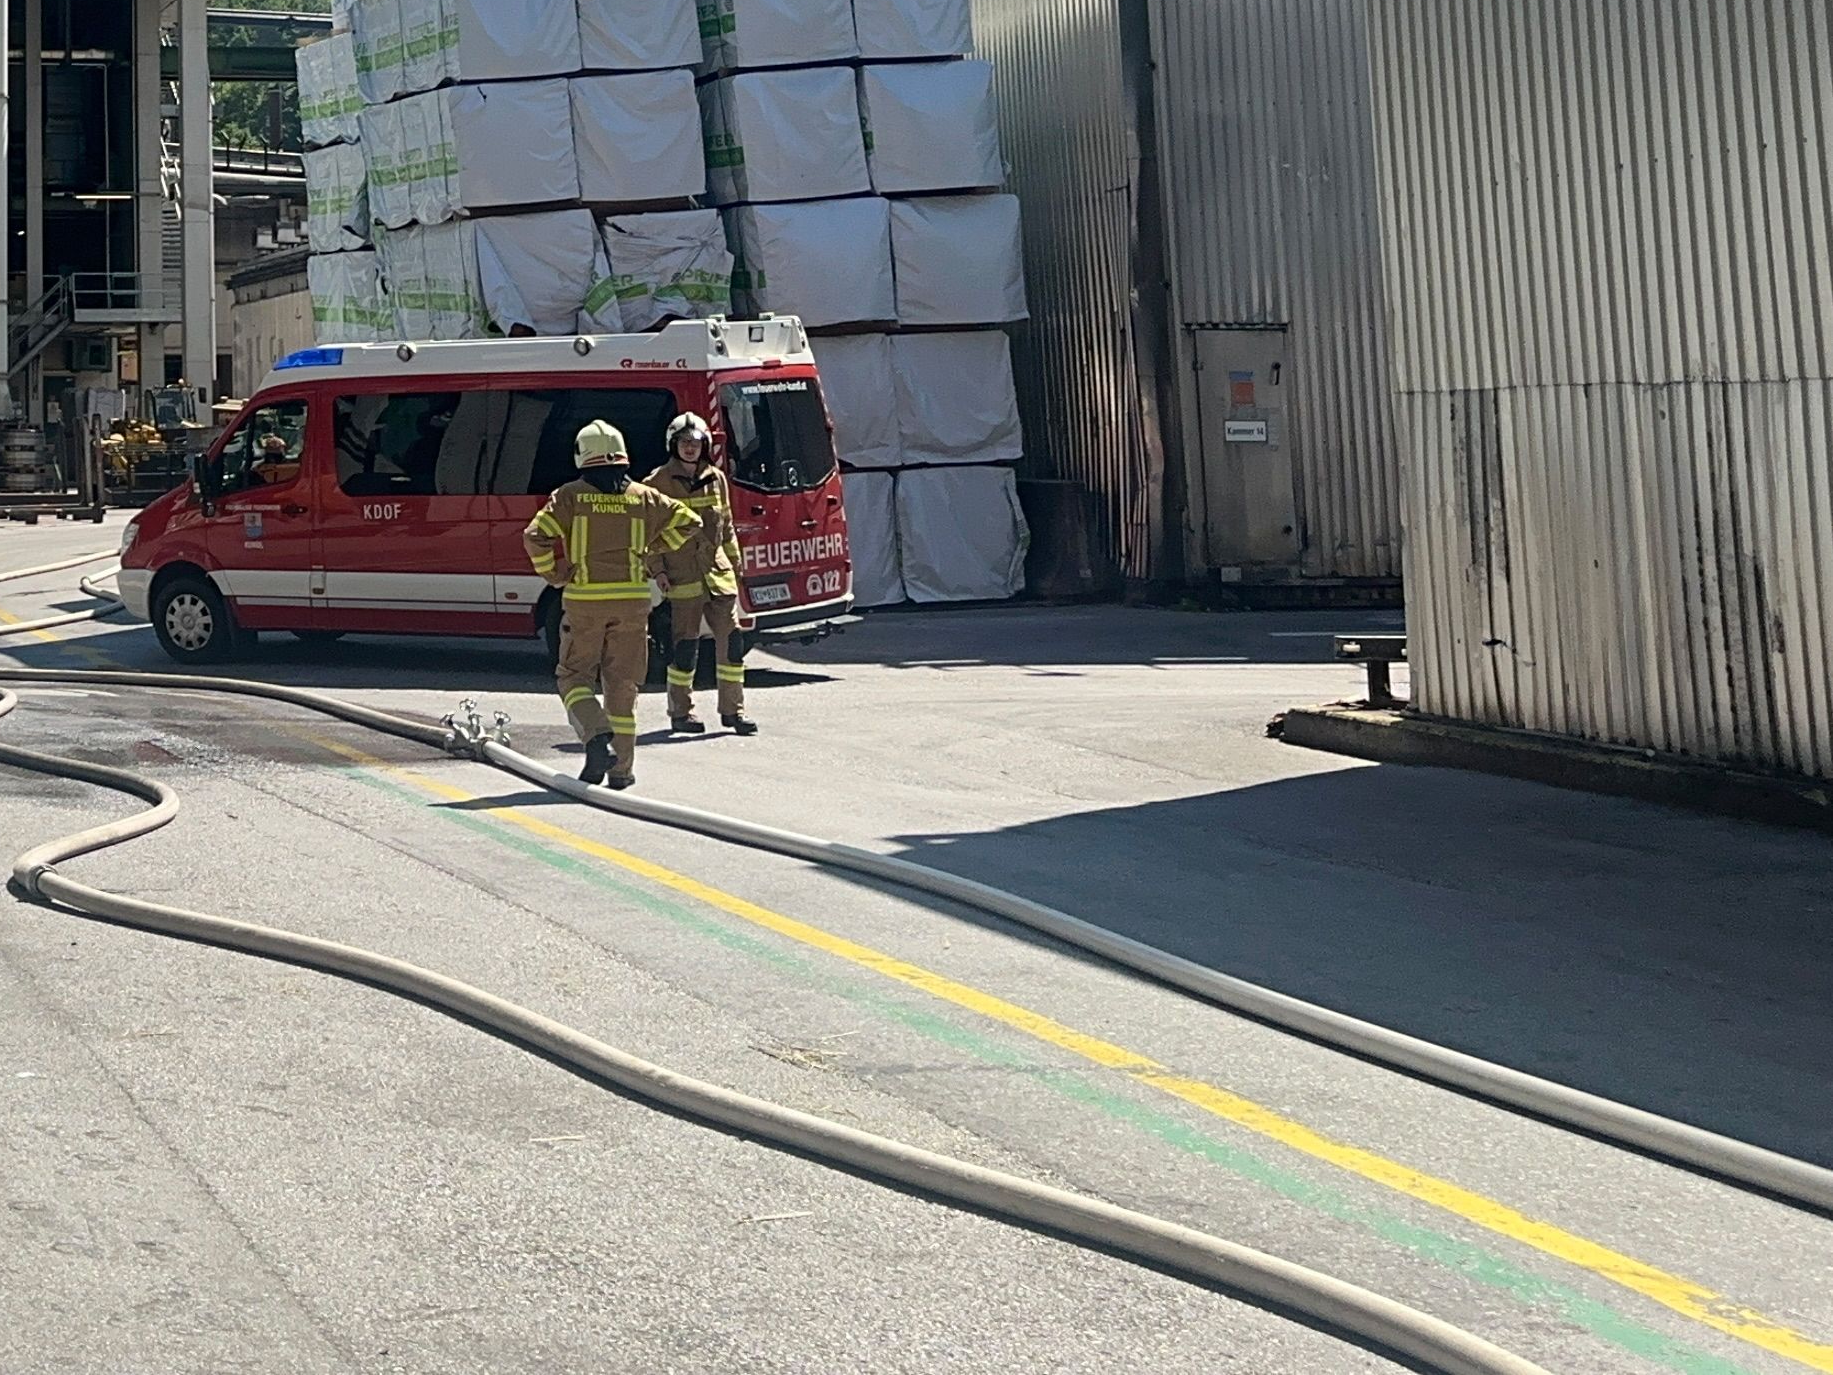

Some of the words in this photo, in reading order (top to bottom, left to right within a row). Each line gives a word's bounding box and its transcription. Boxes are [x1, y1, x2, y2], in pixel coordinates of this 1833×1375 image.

[363, 503, 402, 520] KDOF
[592, 503, 627, 514] KUNDL
[742, 532, 844, 571] FEUERWEHR
[823, 569, 841, 594] 122
